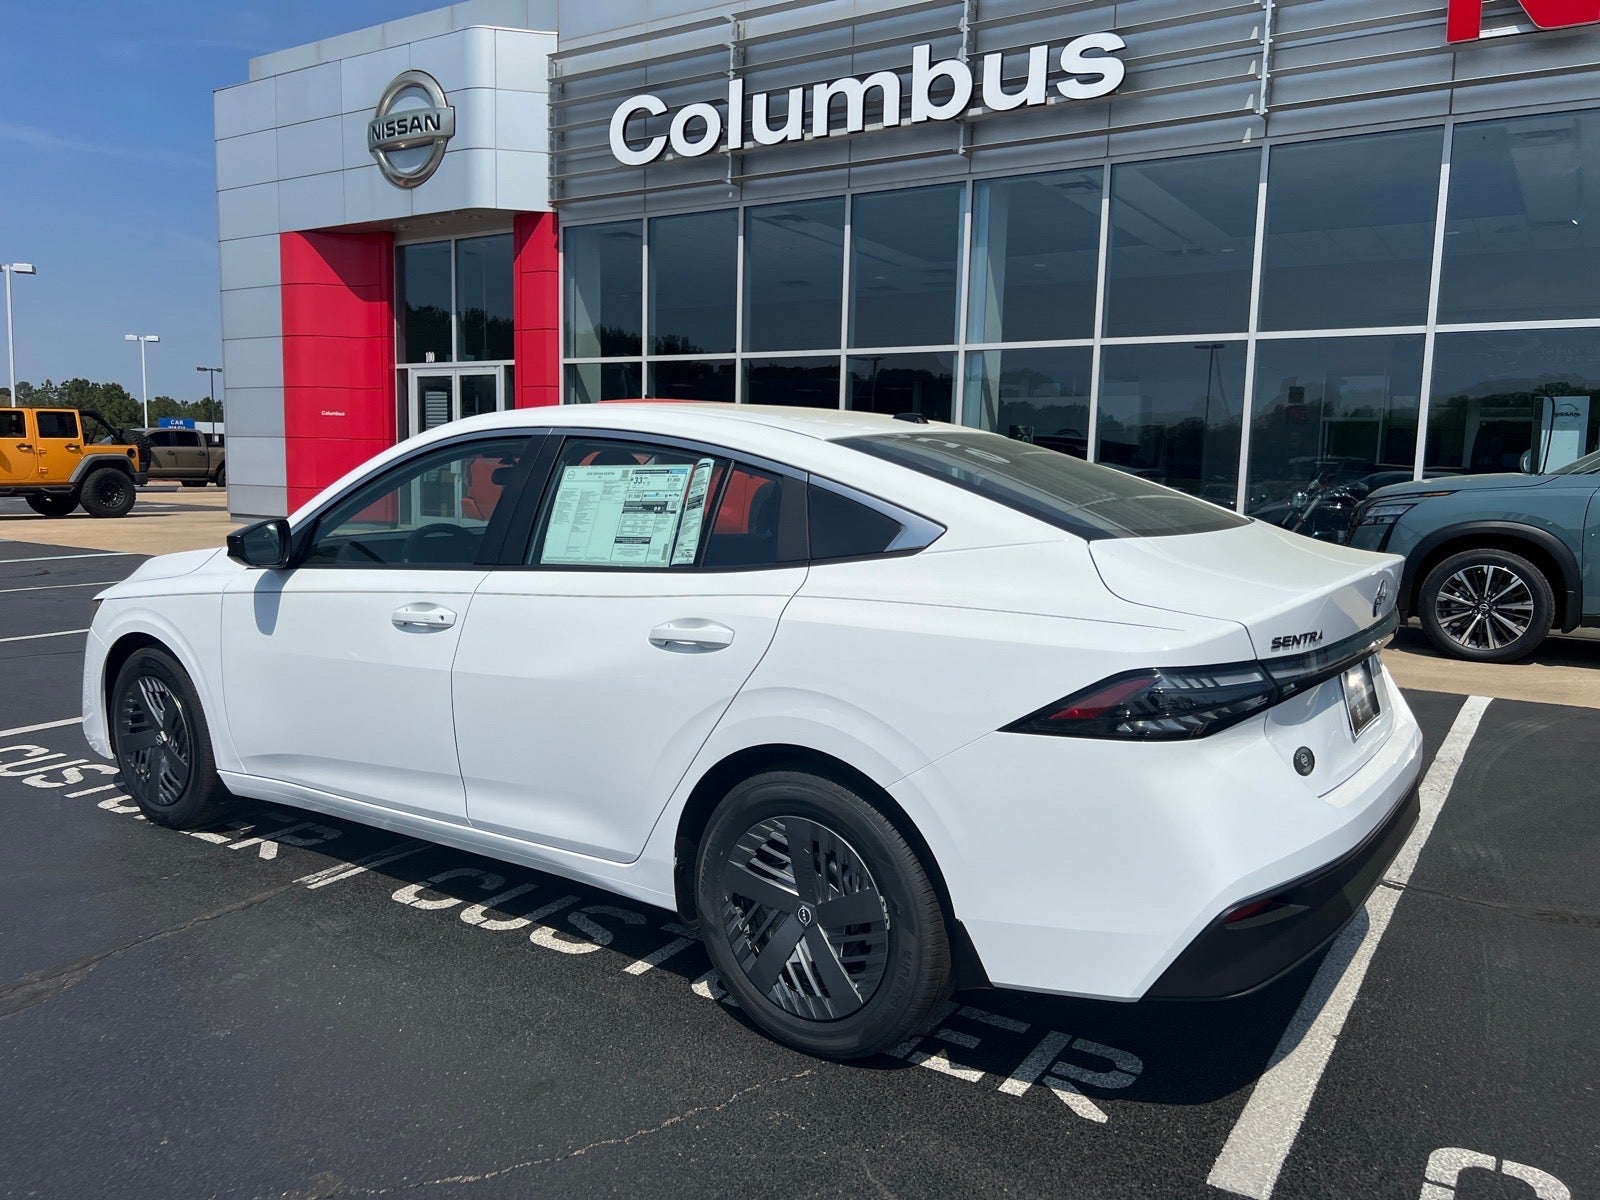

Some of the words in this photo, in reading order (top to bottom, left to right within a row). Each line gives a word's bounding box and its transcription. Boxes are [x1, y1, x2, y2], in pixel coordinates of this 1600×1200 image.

[608, 32, 1126, 166] Columbus
[371, 113, 441, 142] NISSAN
[1271, 629, 1323, 649] SENTRA
